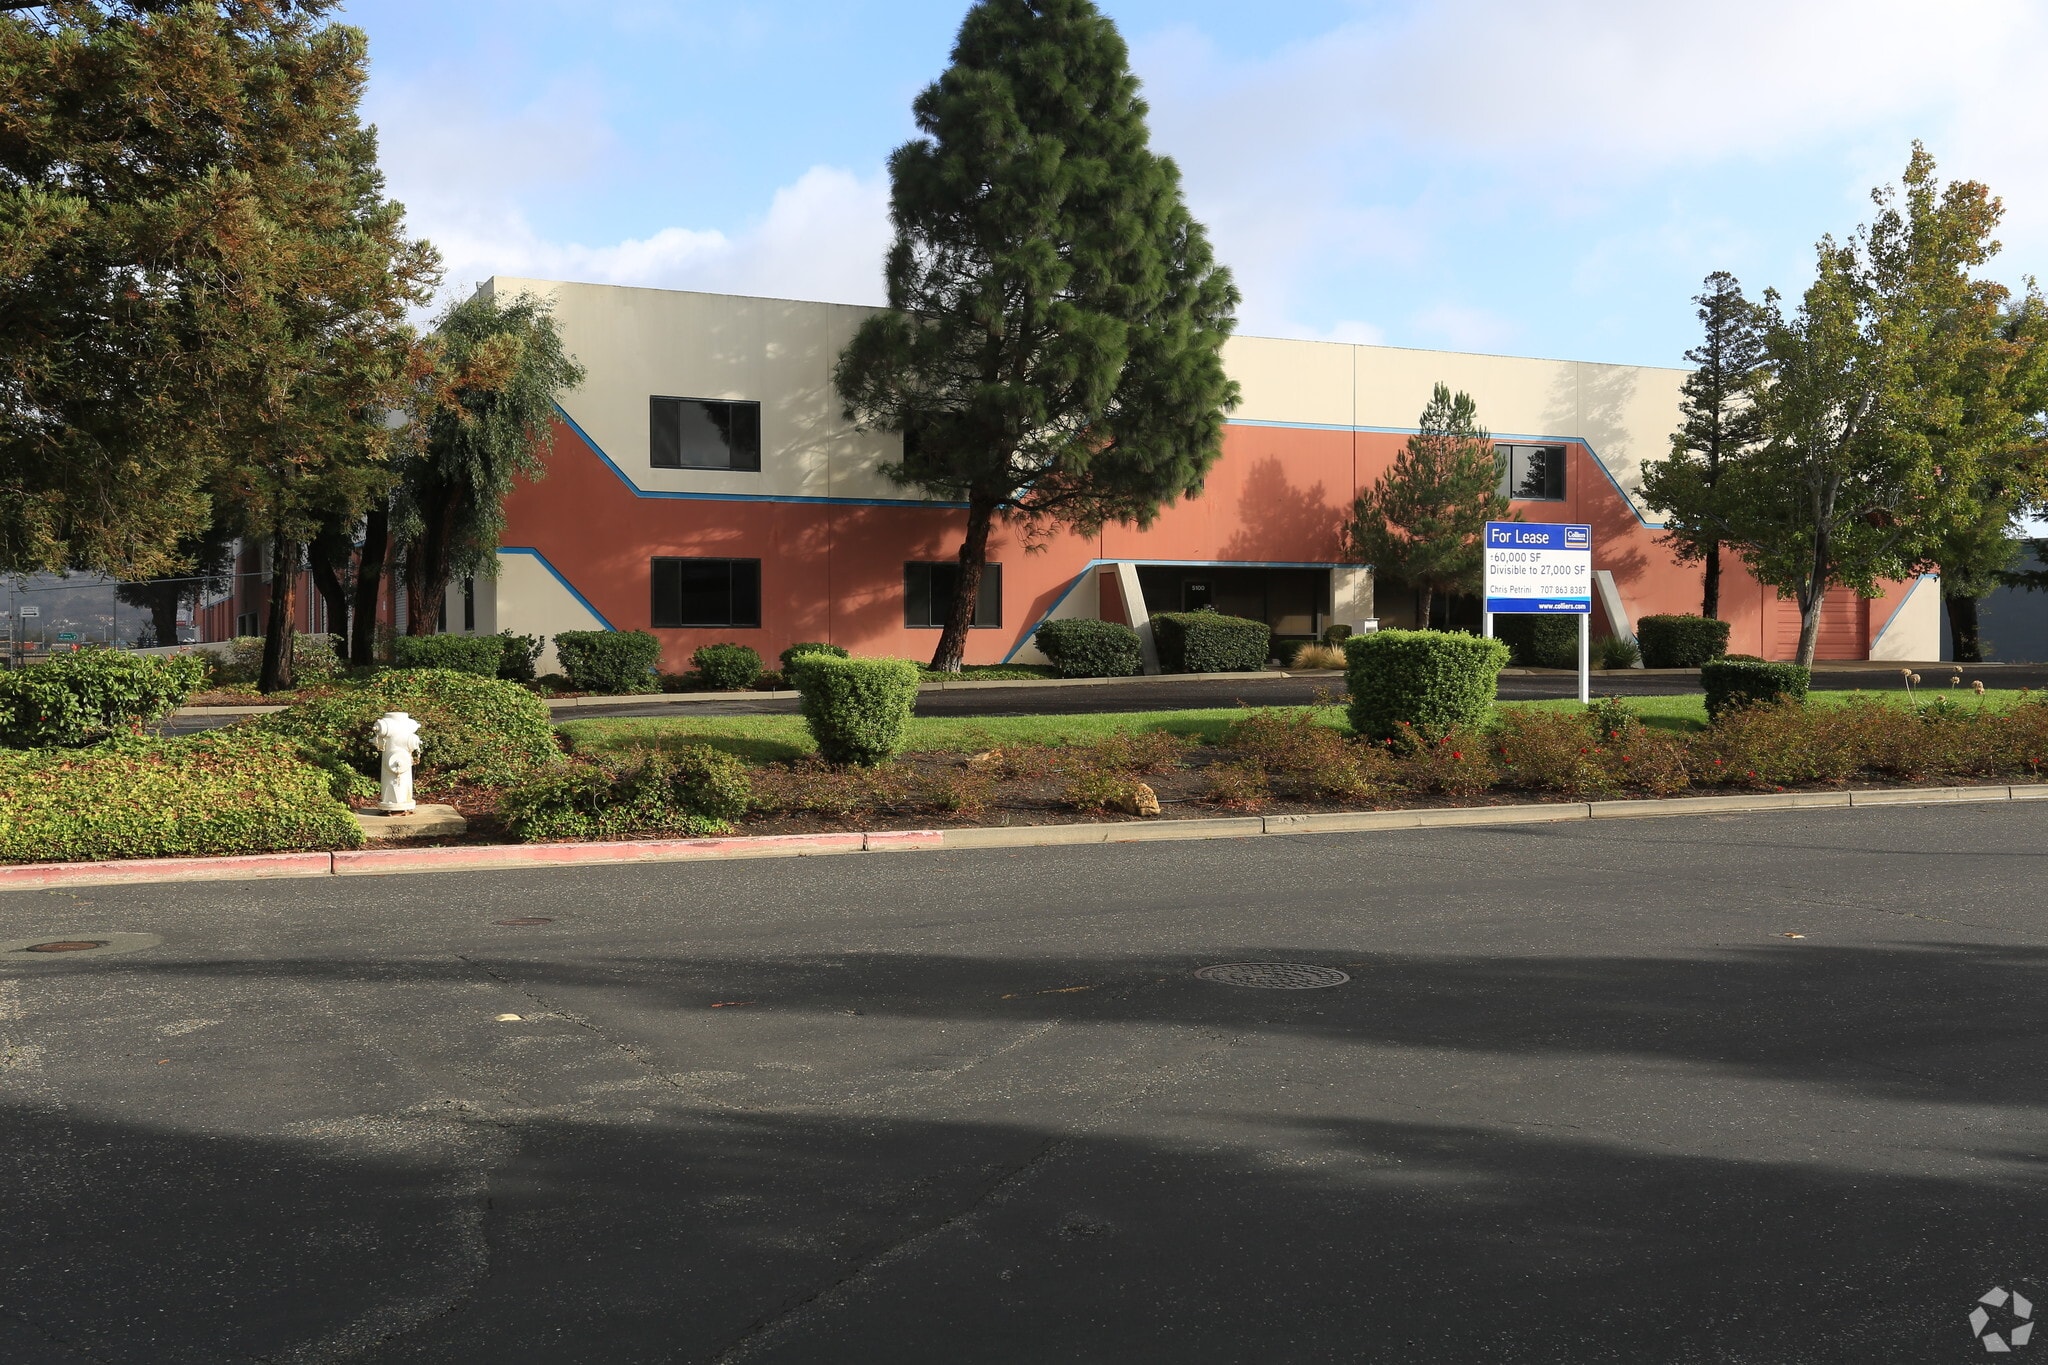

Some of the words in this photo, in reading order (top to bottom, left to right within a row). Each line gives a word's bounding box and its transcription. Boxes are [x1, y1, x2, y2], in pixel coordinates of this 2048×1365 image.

[1492, 529, 1511, 543] For
[1515, 529, 1549, 544] Lease
[1529, 552, 1542, 563] SF
[1490, 565, 1526, 575] Divisible
[1530, 566, 1538, 575] to
[1540, 565, 1571, 576] 27,000
[1574, 565, 1586, 575] SF
[1490, 585, 1508, 593] Chris
[1509, 585, 1532, 593] Petrini
[1540, 585, 1553, 594] 707
[1555, 585, 1568, 594] 863
